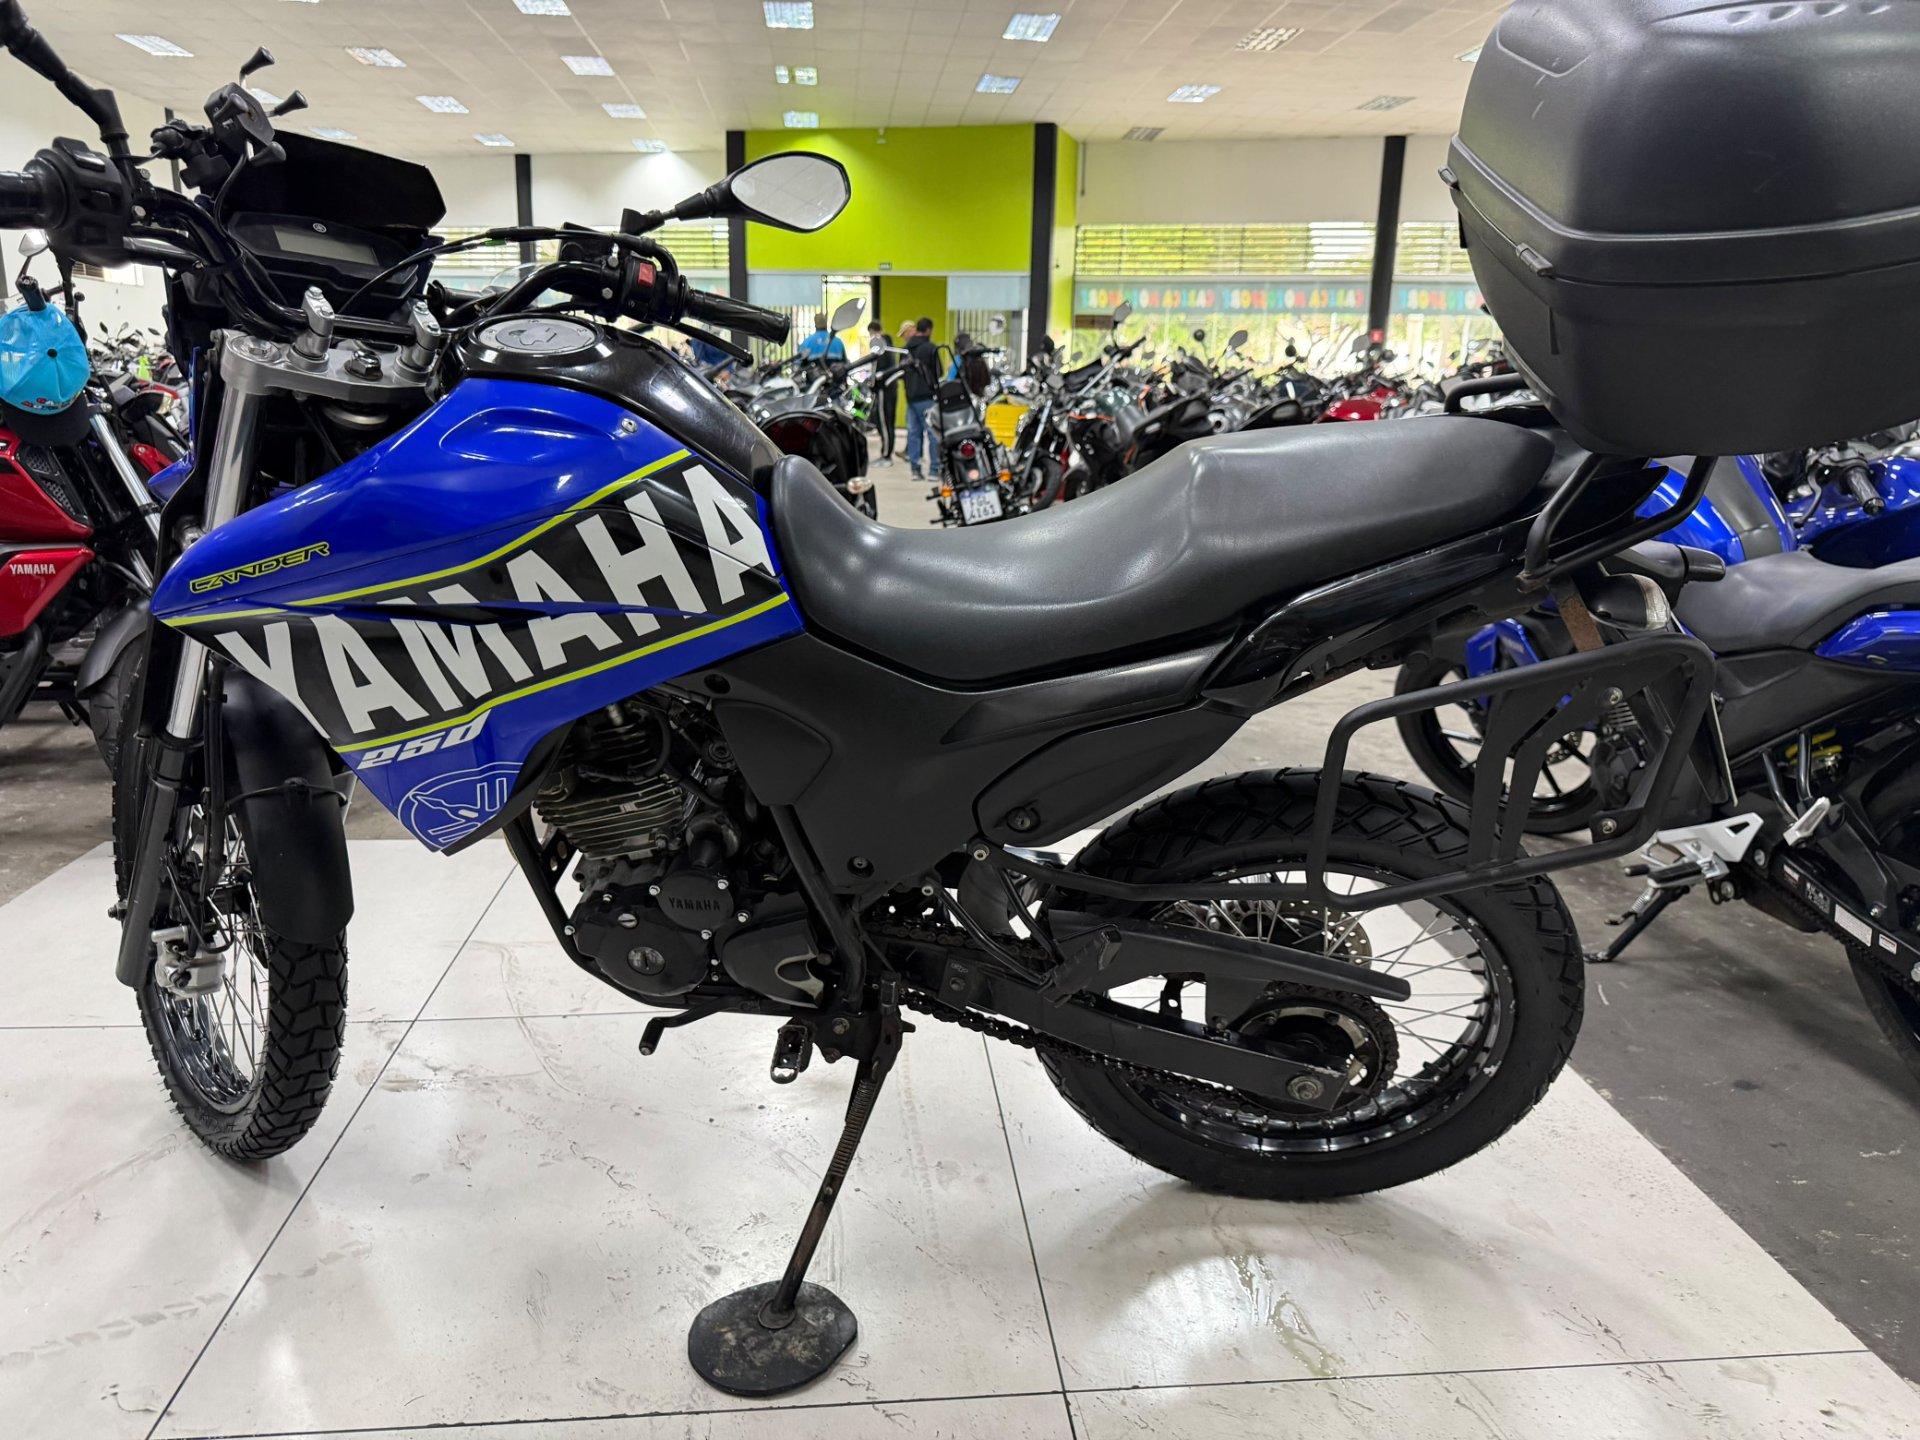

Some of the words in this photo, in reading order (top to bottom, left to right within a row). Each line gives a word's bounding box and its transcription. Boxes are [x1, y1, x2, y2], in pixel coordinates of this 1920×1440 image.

[9, 563, 56, 575] YAMAHA
[214, 464, 776, 738] YAMAHA
[356, 708, 492, 770] 250
[668, 896, 721, 911] YAMAHA
